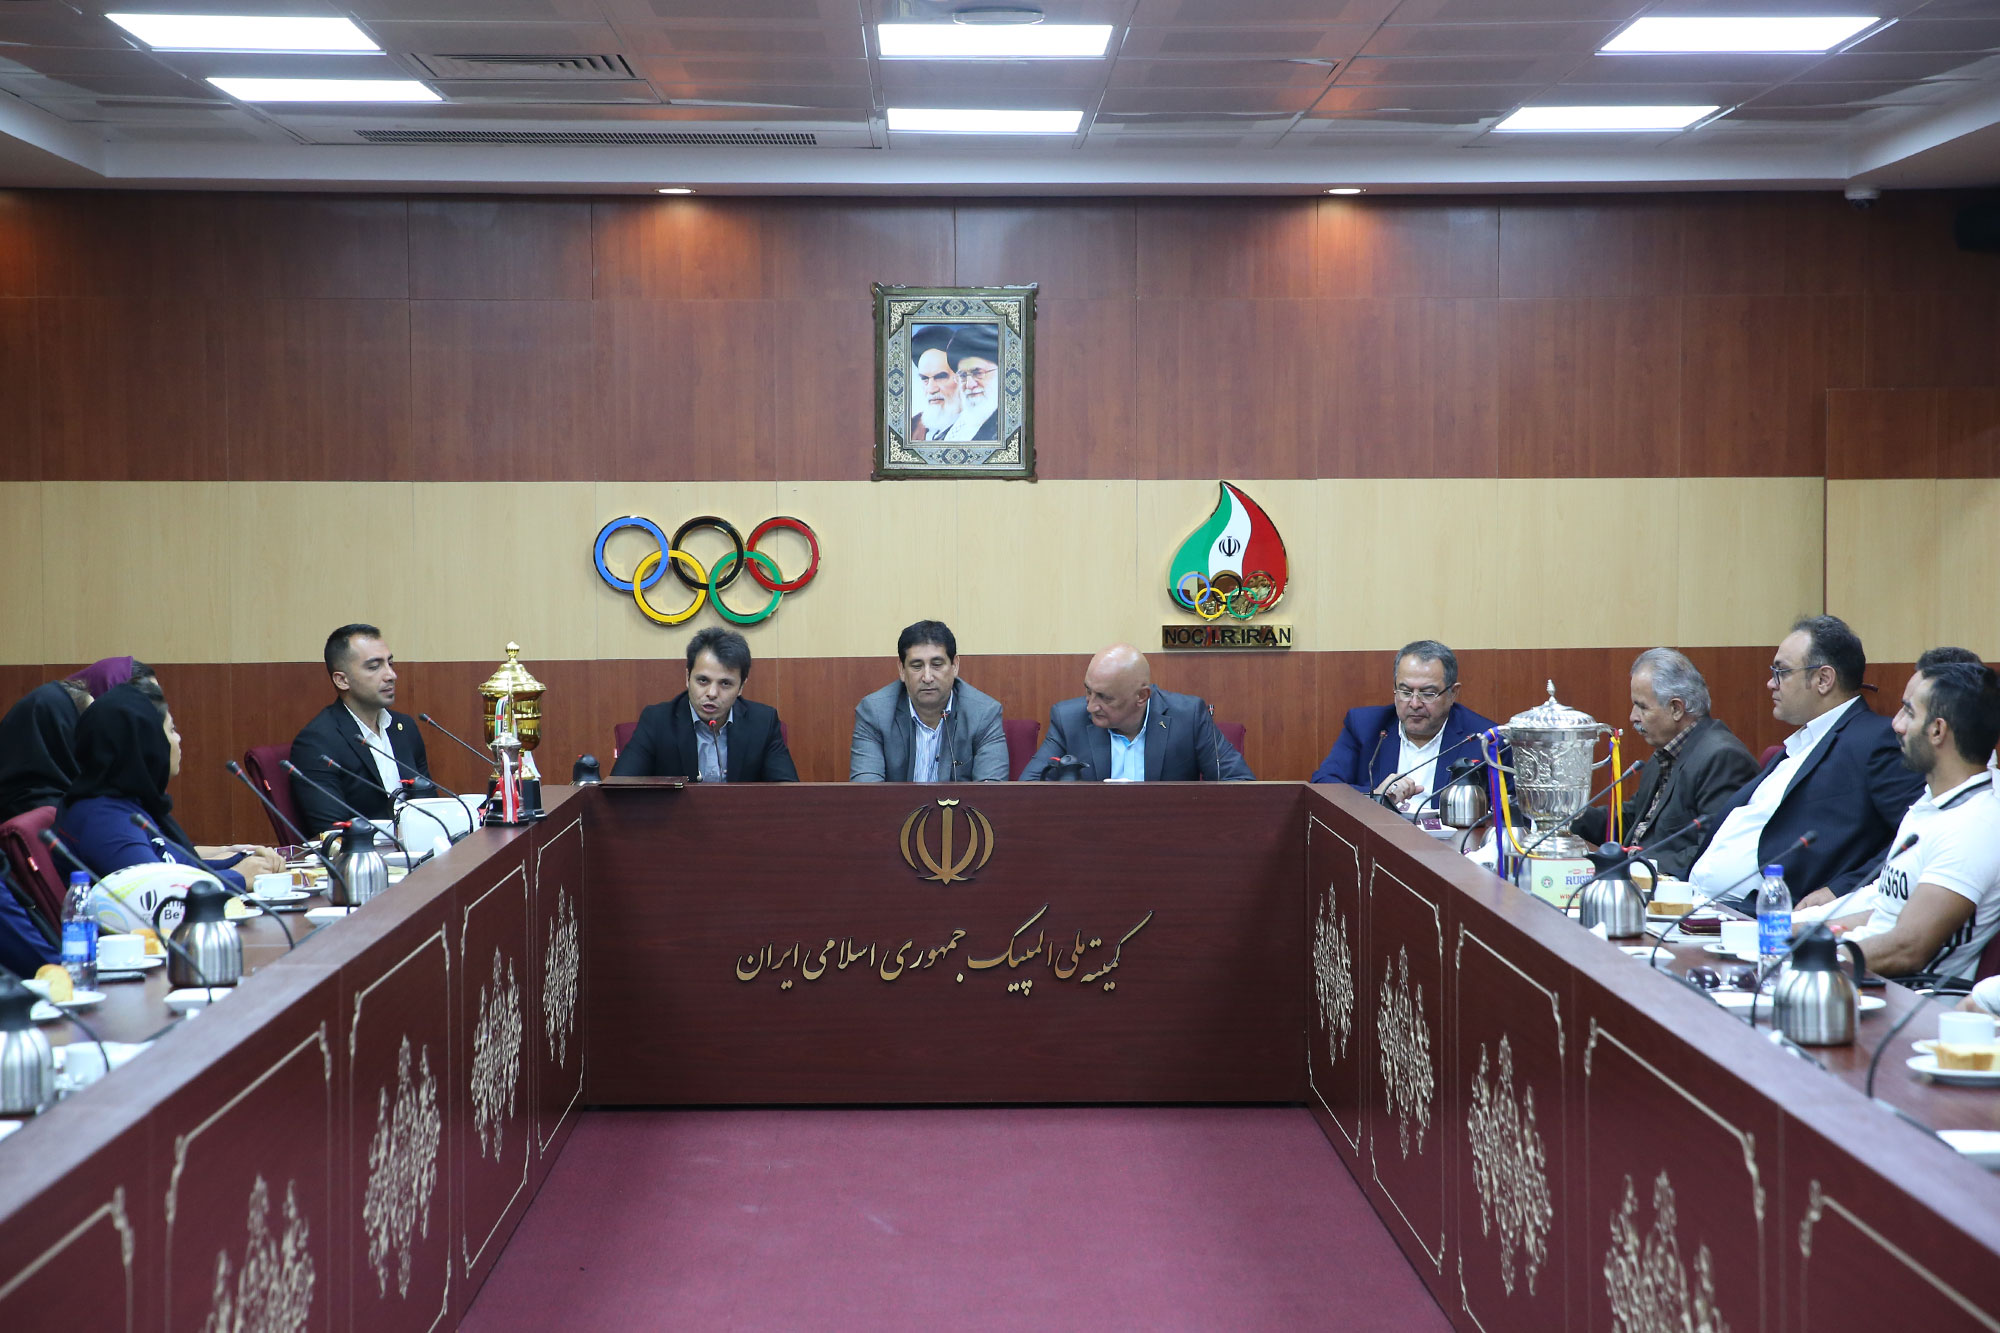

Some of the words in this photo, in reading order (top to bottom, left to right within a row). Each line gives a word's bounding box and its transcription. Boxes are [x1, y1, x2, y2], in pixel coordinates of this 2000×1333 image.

[1164, 628, 1204, 645] NOC
[735, 940, 800, 990] ایران
[801, 936, 877, 981] اسلامی
[879, 928, 967, 984] جمهوری
[967, 903, 1052, 996] المپیک
[1054, 930, 1086, 979] ملی
[1079, 910, 1153, 991] کمیته
